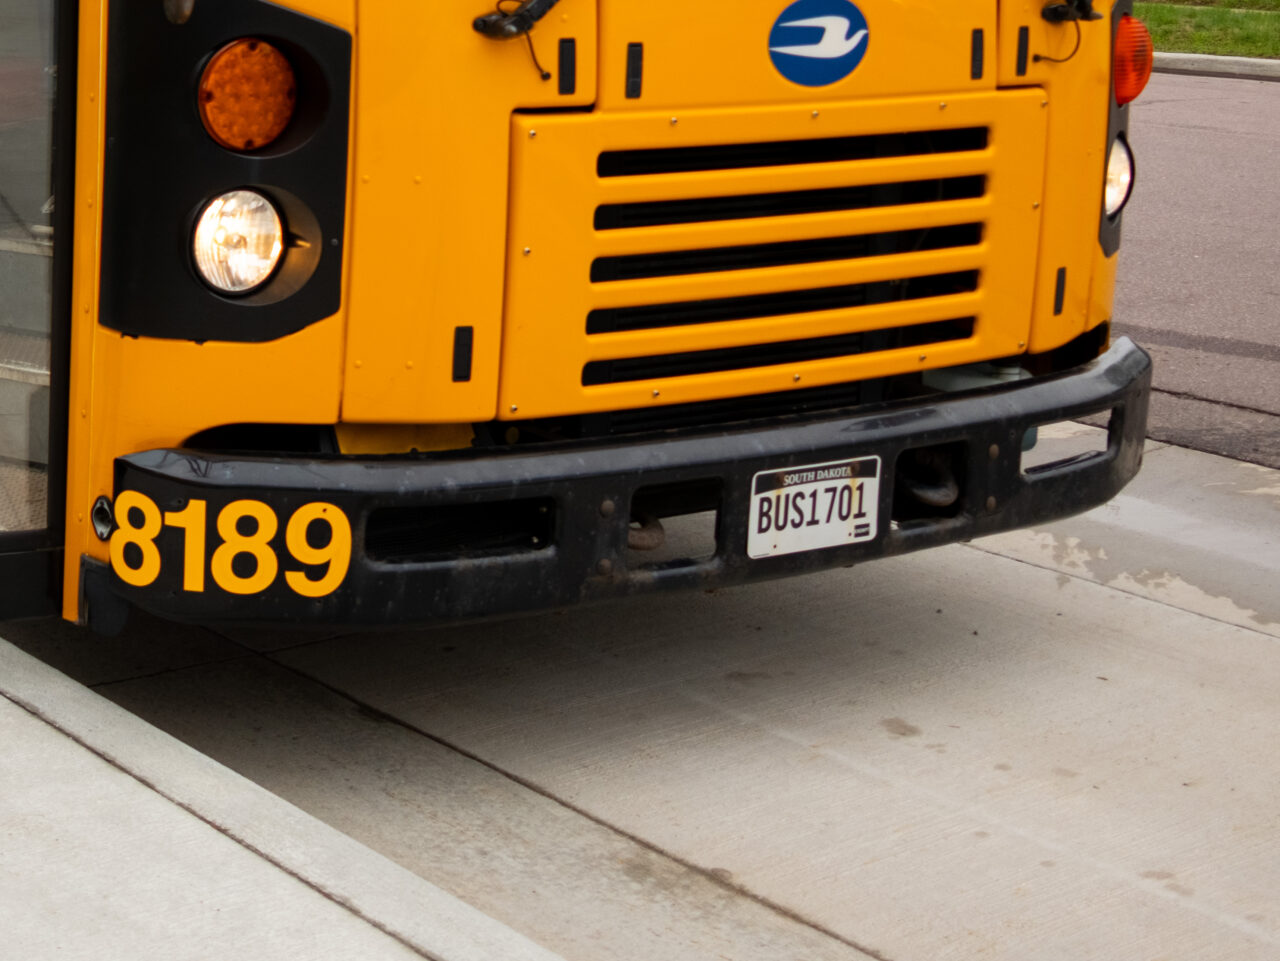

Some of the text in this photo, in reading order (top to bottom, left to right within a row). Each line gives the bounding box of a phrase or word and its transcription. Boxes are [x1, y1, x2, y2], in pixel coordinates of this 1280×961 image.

[783, 466, 853, 485] SOUTH DAKOTA
[757, 482, 867, 534] BUS1701
[109, 489, 353, 598] 8189
